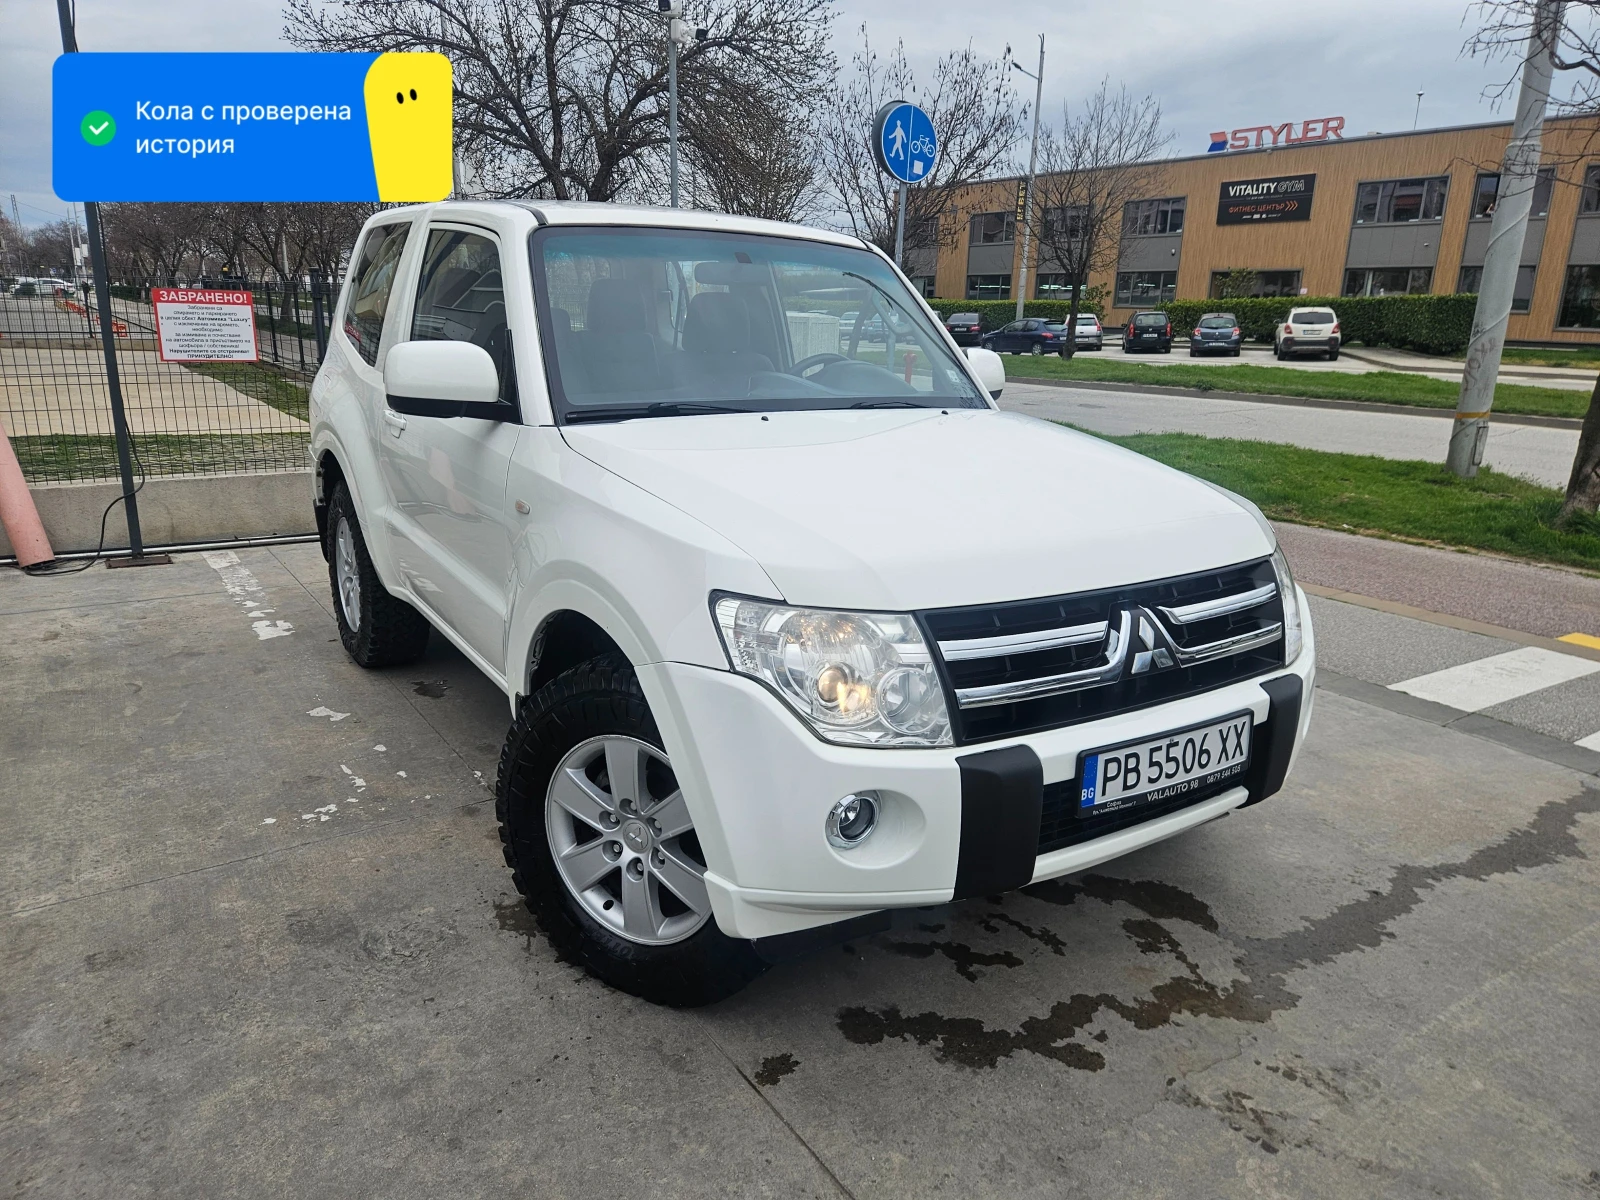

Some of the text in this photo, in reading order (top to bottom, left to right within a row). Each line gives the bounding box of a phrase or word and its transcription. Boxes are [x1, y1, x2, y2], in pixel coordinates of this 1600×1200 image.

[1230, 116, 1345, 149] STYLER
[1229, 180, 1305, 196] VITALITY GYM
[1229, 203, 1285, 213] ФИТНЕС ЦЕНТЪР
[160, 290, 247, 303] ЗАБРАНЕНО!
[1101, 721, 1247, 796] PB 5506 XX
[1081, 787, 1095, 800] BG
[1147, 783, 1188, 802] VALAUTO
[1190, 779, 1199, 790] 98
